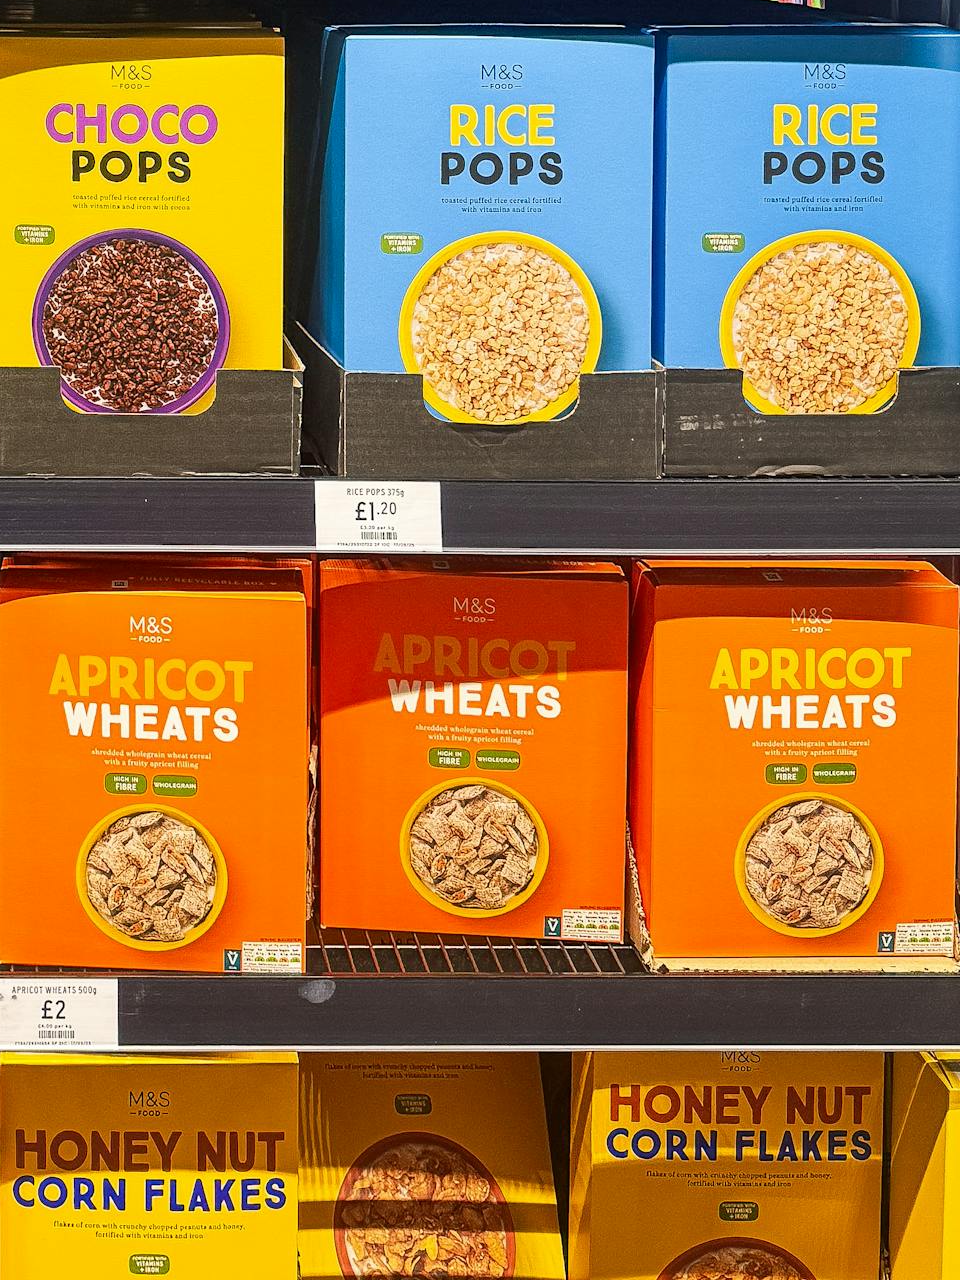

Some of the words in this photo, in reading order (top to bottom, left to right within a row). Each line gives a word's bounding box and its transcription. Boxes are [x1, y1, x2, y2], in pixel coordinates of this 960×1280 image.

[111, 65, 152, 80] M&S
[481, 65, 523, 80] M&S
[46, 104, 218, 144] CHOCO
[450, 104, 555, 146] RICE
[72, 151, 191, 182] POPS
[441, 153, 563, 185] POPS
[346, 488, 364, 496] RICE
[365, 488, 386, 496] POPS
[387, 488, 405, 497] 375g
[355, 501, 397, 521] £1.20
[454, 597, 495, 615] M&S
[130, 616, 172, 634] M&S
[374, 633, 576, 681] APRICOT
[710, 647, 912, 690] APRICOT
[49, 654, 253, 703] APRICOT
[388, 679, 562, 718] WHEATS
[724, 694, 897, 729] WHEATS
[63, 701, 239, 743] WHEATS
[115, 783, 137, 791] FIBRE
[154, 782, 196, 790] WHOLEGRAIN
[11, 986, 43, 994] APRICOT
[45, 986, 76, 994] WHEATS
[78, 986, 97, 996] 500g
[41, 1000, 66, 1019] £2
[129, 1091, 170, 1107] M&S
[15, 1129, 182, 1172] HONEY
[197, 1131, 285, 1172] NUT
[13, 1175, 126, 1211] CORN
[145, 1177, 286, 1212] FLAKES
